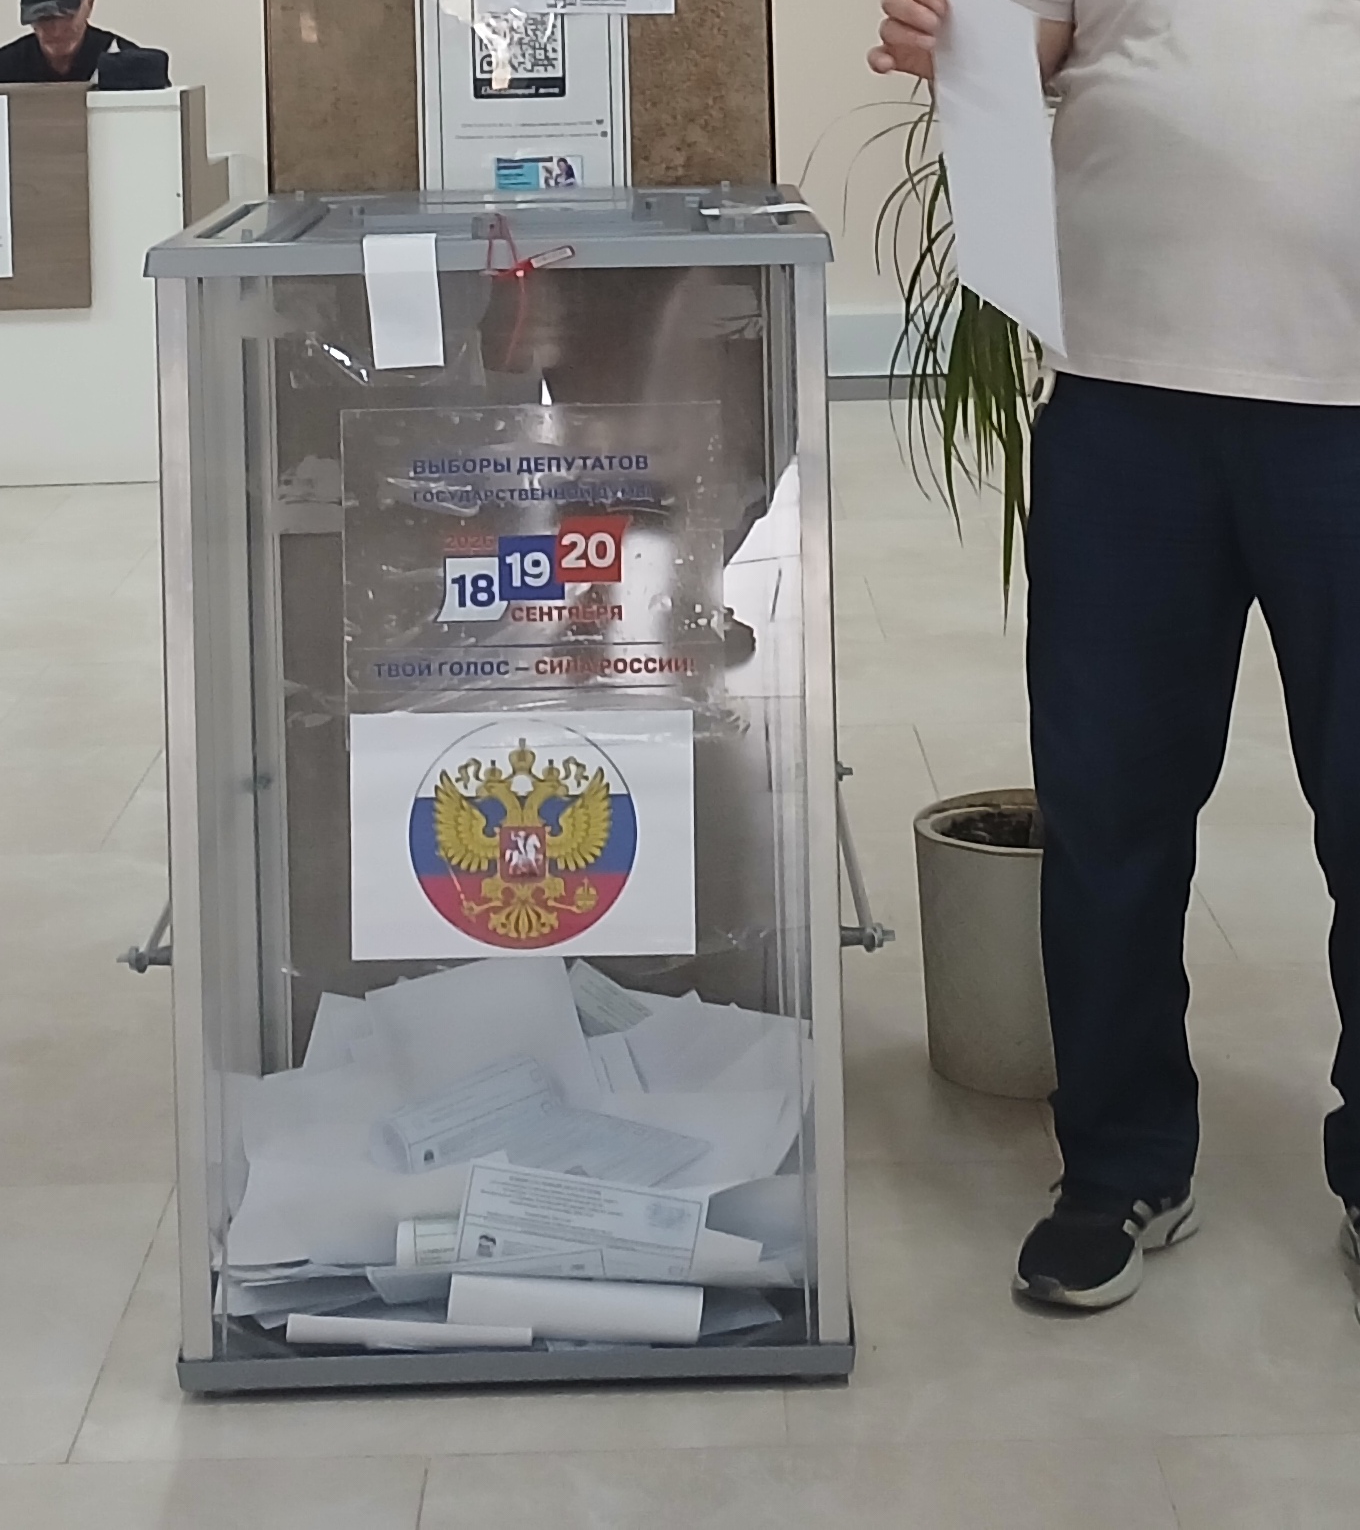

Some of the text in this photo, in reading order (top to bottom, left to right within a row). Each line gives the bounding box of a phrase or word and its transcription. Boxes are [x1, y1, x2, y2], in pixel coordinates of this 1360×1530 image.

[412, 454, 649, 476] ВЫБОРЫ ДЕПУТАТОВ
[412, 484, 595, 505] ГОСУДАРСТВЕННОЙ
[450, 531, 616, 609] 18 19 20
[510, 603, 623, 622] СЕНТЯБРЯ
[374, 657, 433, 679] ТВОЙ
[438, 659, 511, 678] ГОЛОС
